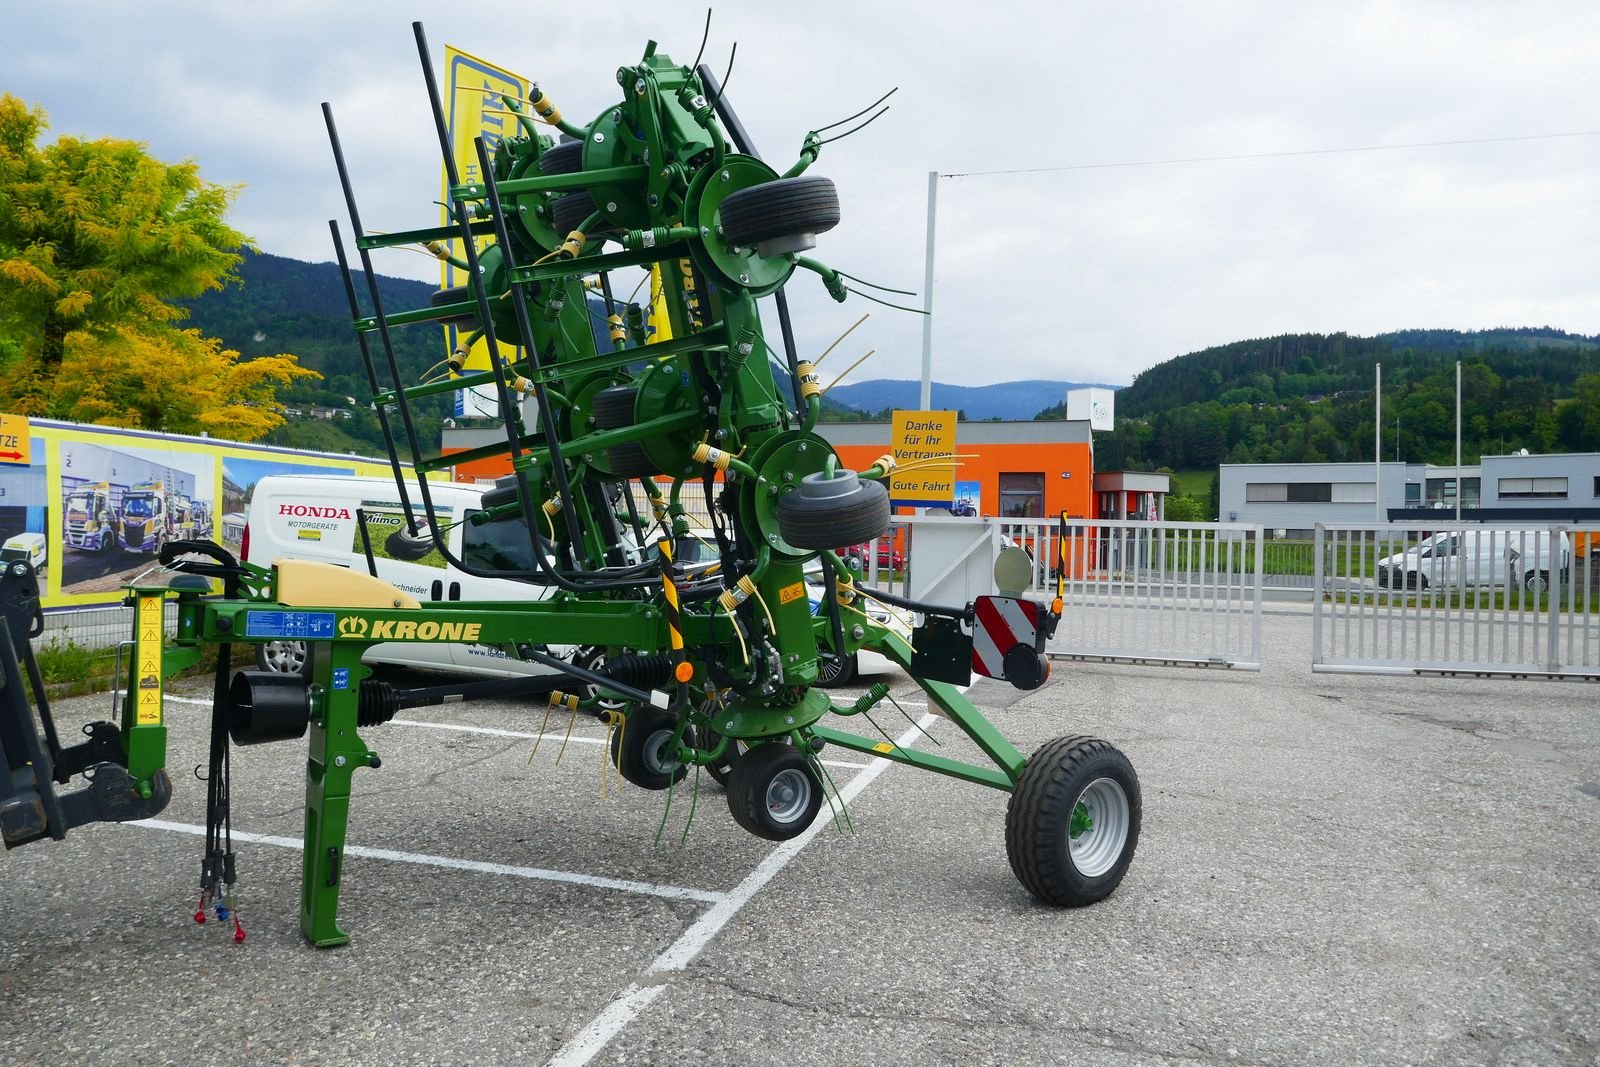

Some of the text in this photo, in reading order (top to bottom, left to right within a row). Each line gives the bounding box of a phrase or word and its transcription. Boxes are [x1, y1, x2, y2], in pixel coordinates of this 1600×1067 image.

[905, 421, 942, 431] Danke
[904, 434, 941, 445] für Ihr
[894, 449, 952, 460] Vertrauen
[893, 481, 951, 491] Gute Fahrt
[279, 504, 352, 520] HONDA
[287, 520, 339, 531] MOTORGERÄTE
[370, 620, 482, 641] KRONE
